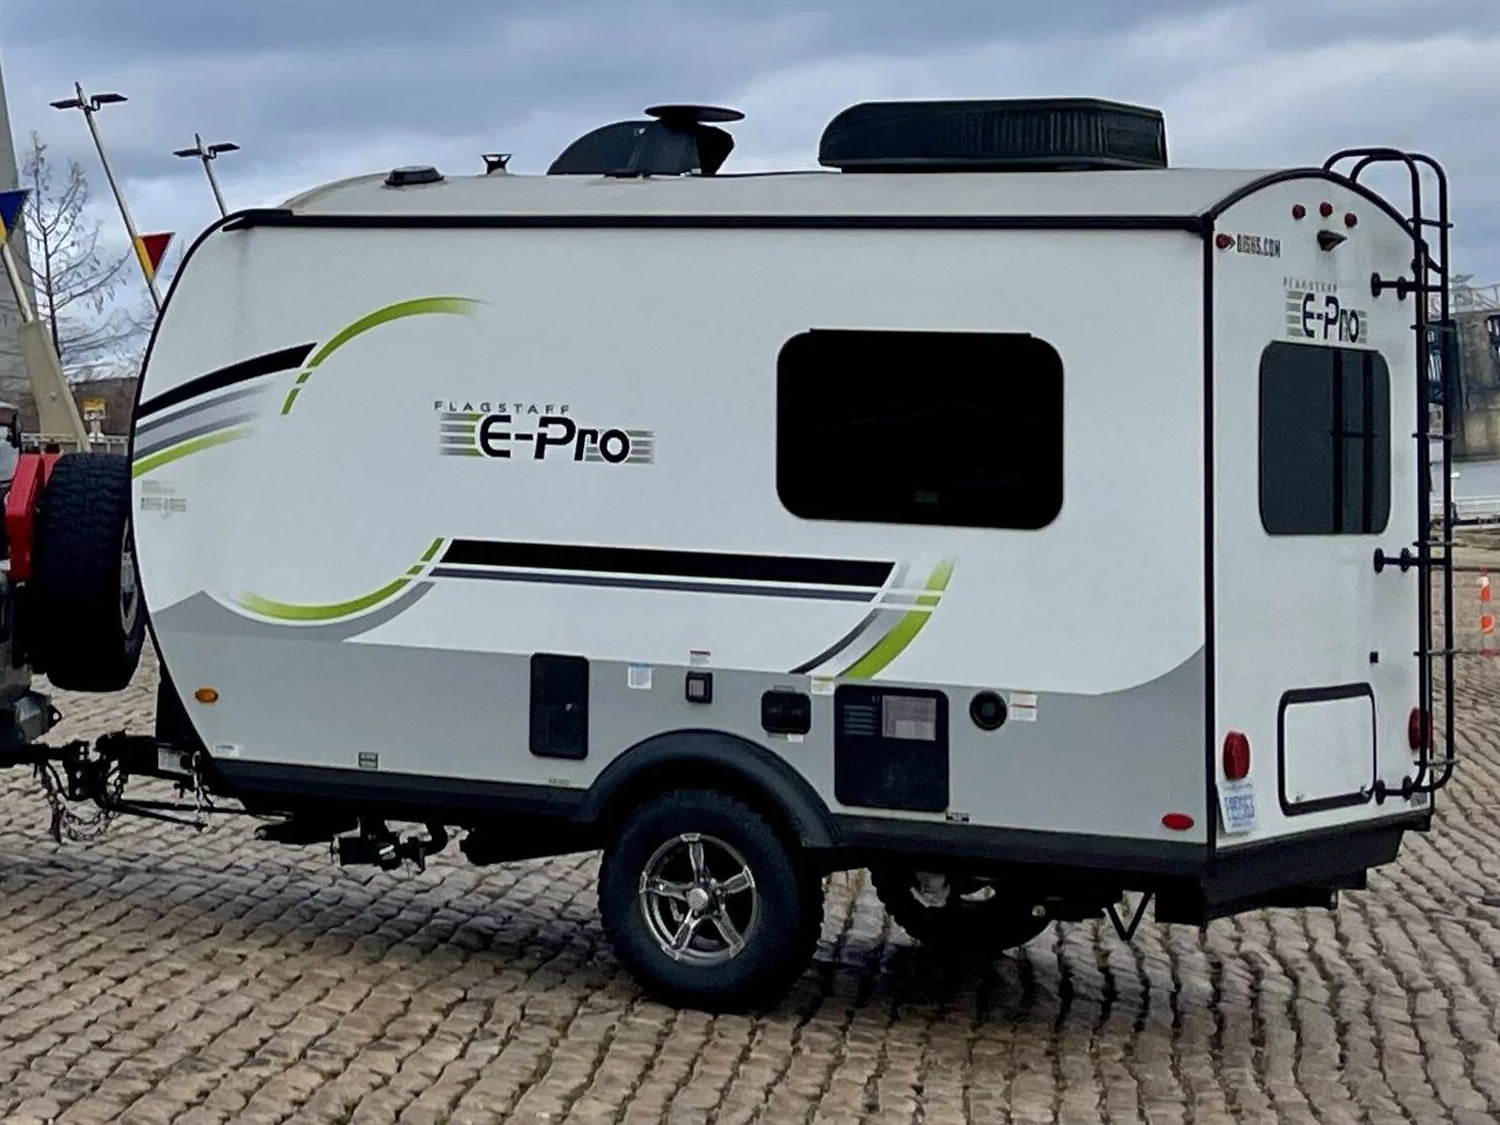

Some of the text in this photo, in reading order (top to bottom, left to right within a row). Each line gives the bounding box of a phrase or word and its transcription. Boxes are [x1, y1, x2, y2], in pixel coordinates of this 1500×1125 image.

[1303, 292, 1359, 343] E-Pro
[434, 401, 570, 414] FLAGSTAFF
[479, 414, 631, 463] E-Pro
